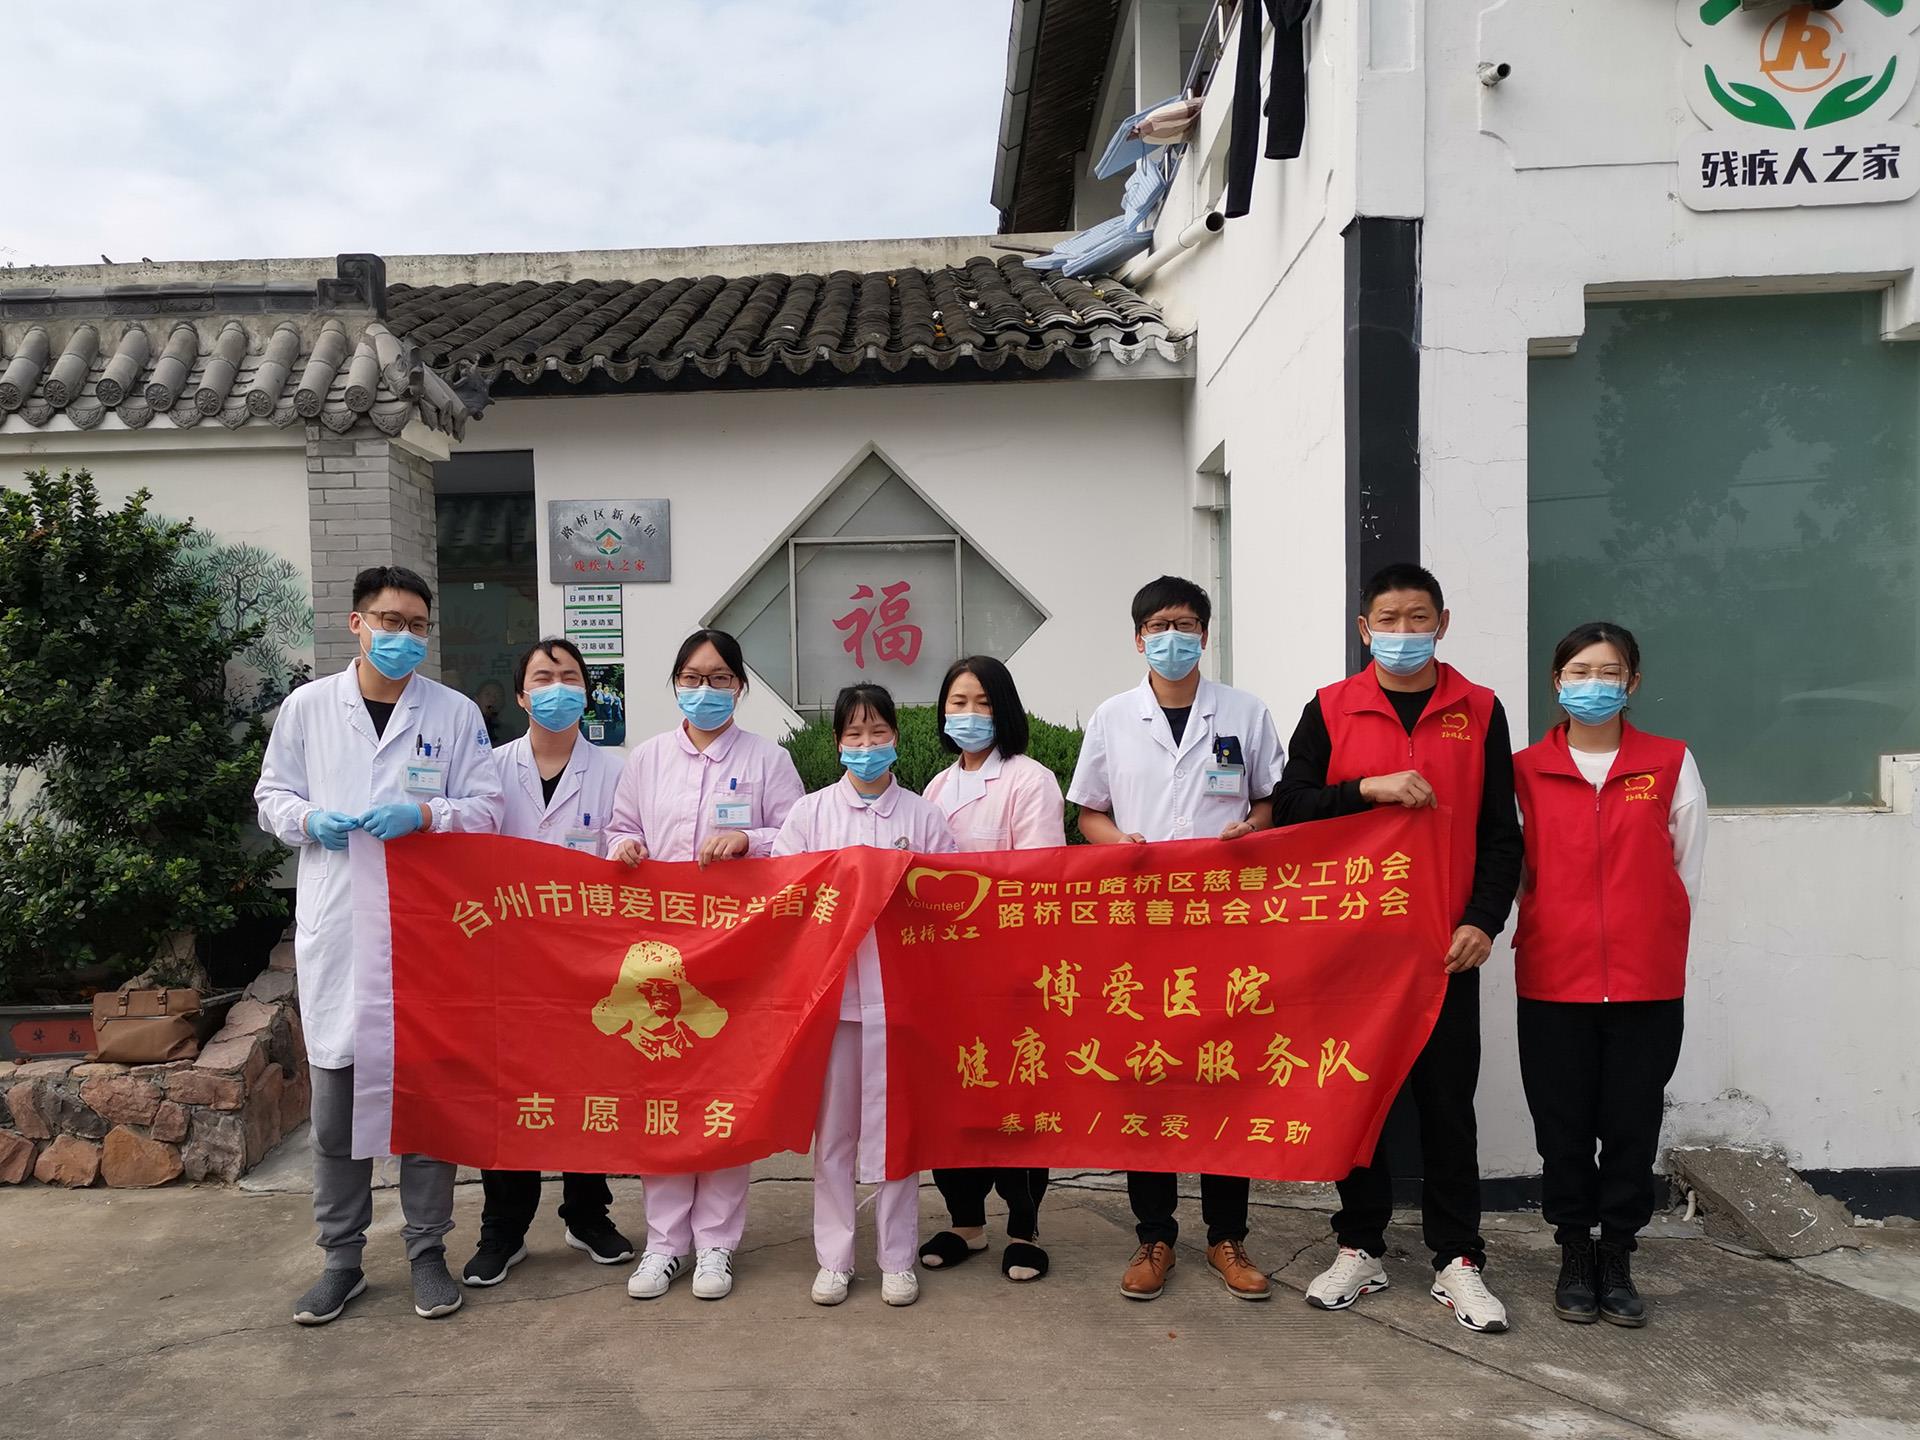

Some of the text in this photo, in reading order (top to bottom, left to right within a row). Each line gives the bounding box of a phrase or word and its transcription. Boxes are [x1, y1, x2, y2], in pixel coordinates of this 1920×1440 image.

[1701, 143, 1900, 188] 残疾人之家
[574, 559, 646, 573] 残疾人之家
[572, 618, 614, 627] 文体活动室
[832, 580, 923, 669] 福
[905, 897, 966, 913] Volunteer
[998, 886, 1411, 929] 路桥区慈善总会义工分会
[1033, 959, 1276, 1021] 博爱医院
[956, 1026, 1370, 1089] 健康义诊服务队
[516, 1092, 737, 1138] 志愿服务
[998, 1112, 1063, 1135] 奉献
[1120, 1113, 1191, 1140] 友爱
[1246, 1118, 1312, 1145] 互助
